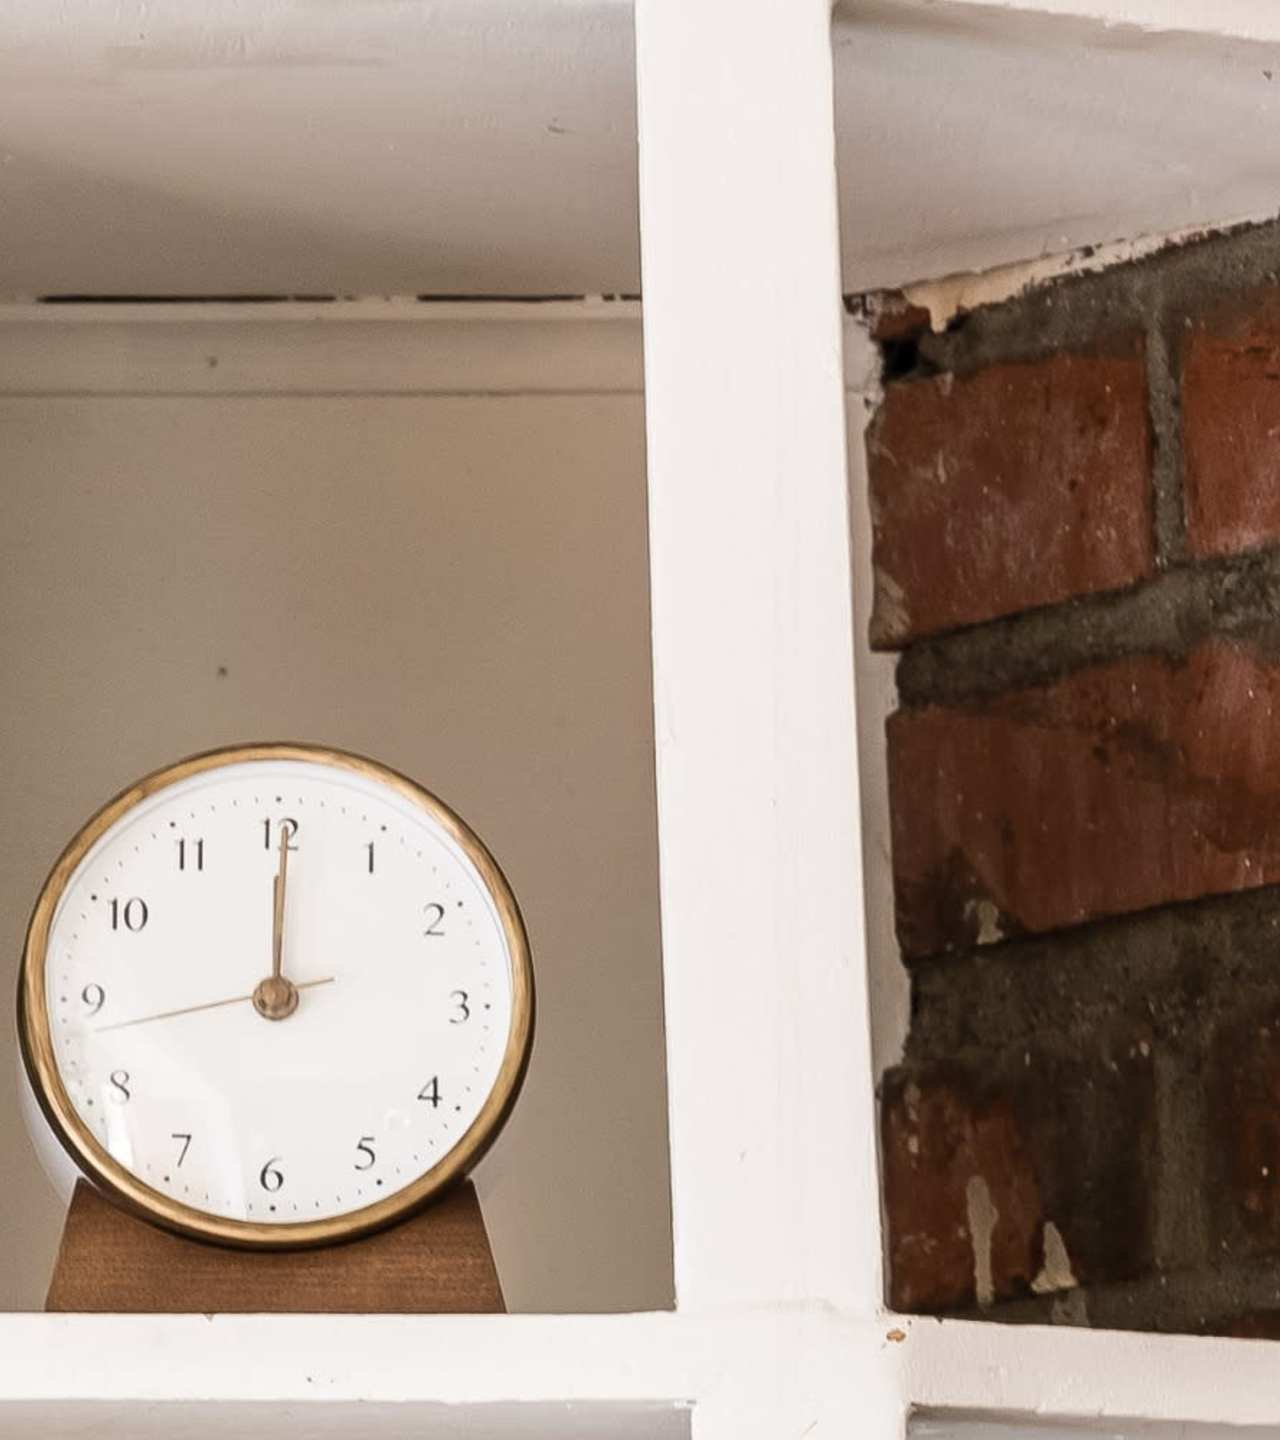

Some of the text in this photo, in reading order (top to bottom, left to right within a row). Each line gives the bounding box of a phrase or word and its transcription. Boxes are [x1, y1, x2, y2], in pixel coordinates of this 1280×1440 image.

[262, 817, 300, 852] 12
[175, 837, 205, 872] 11
[365, 841, 376, 874] 1
[109, 896, 149, 932] 10
[422, 903, 447, 937] 2
[81, 983, 106, 1017] 9
[448, 989, 471, 1024] 3
[108, 1068, 132, 1104] 8
[417, 1074, 443, 1109] 4
[170, 1133, 193, 1168] 7
[354, 1136, 377, 1171] 5
[259, 1157, 285, 1192] 6
